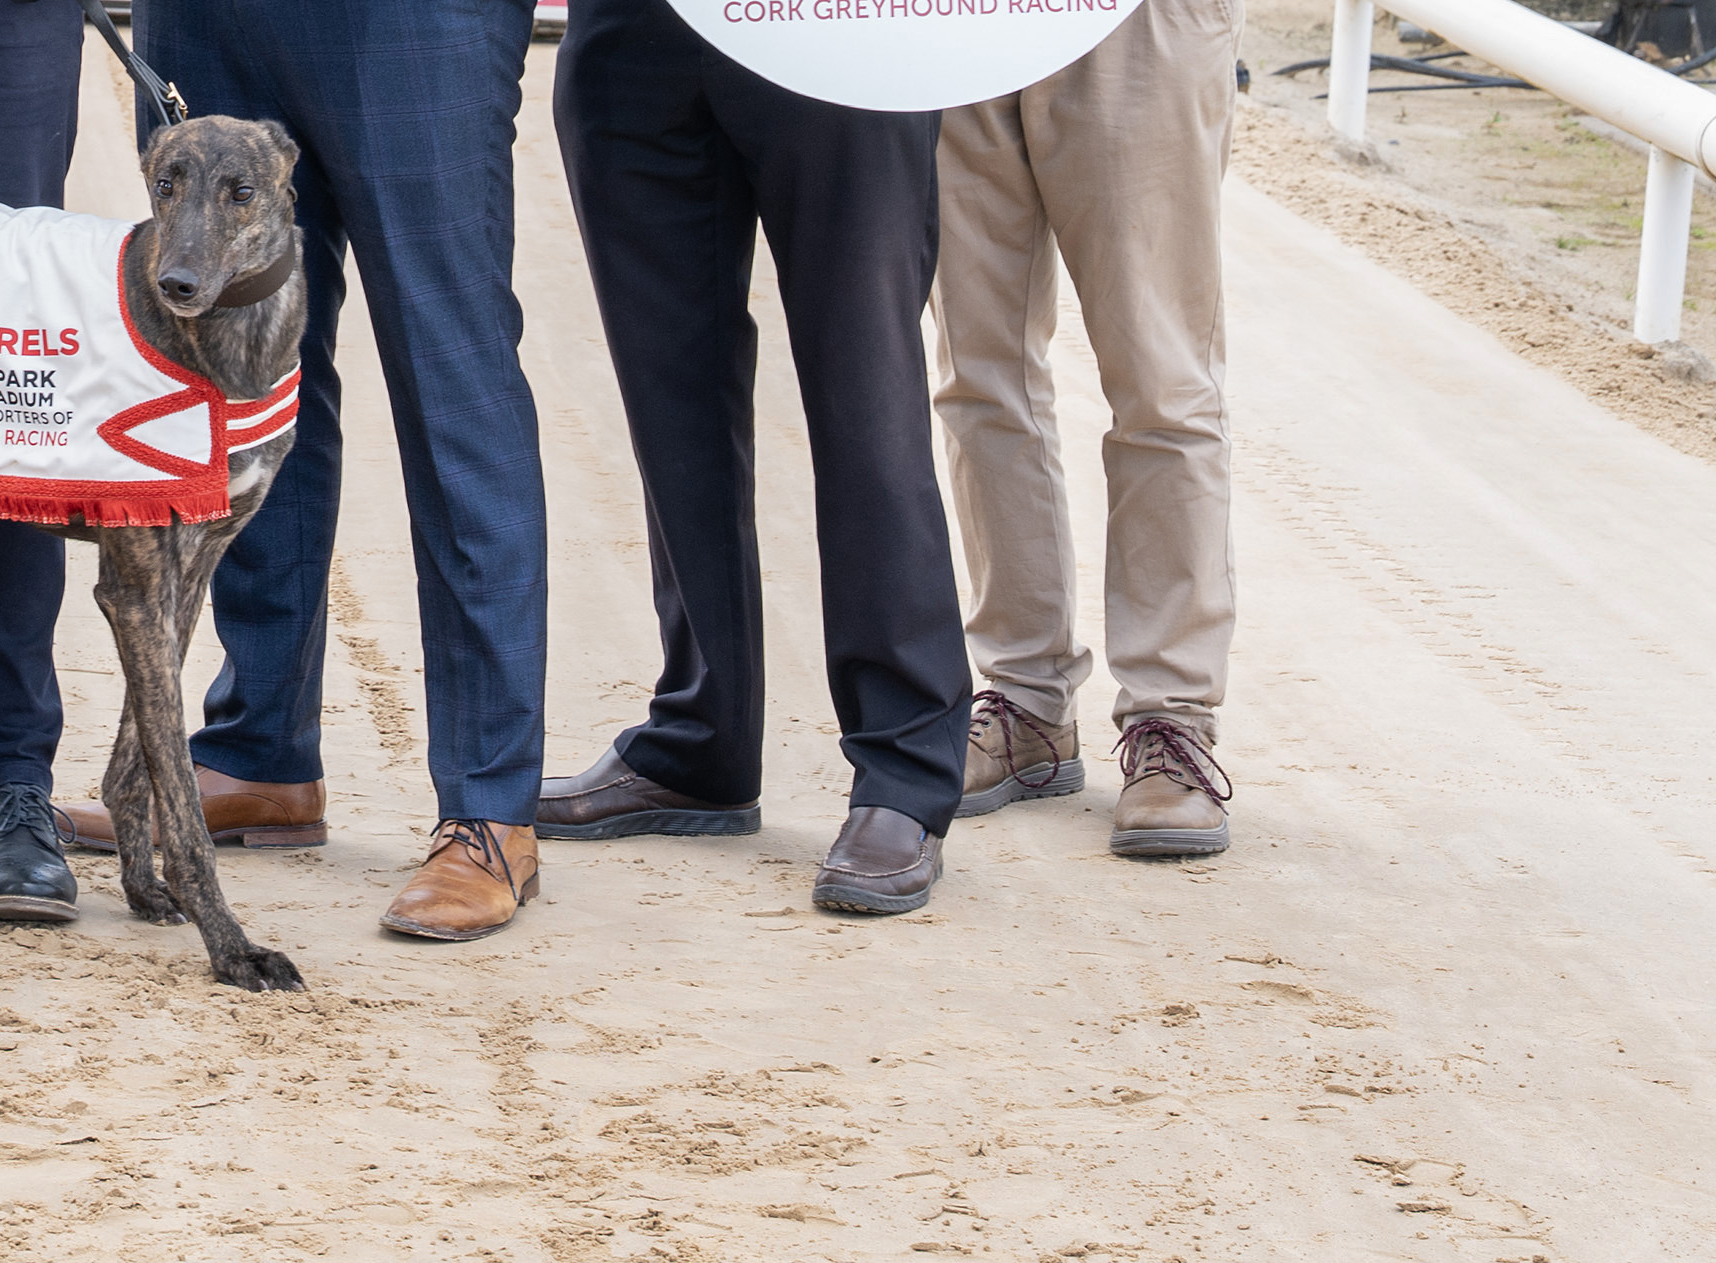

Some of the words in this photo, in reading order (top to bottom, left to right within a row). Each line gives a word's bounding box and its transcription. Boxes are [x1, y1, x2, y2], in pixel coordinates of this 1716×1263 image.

[724, 0, 805, 23] CORK
[53, 411, 73, 425] OF
[4, 429, 68, 446] RACING
